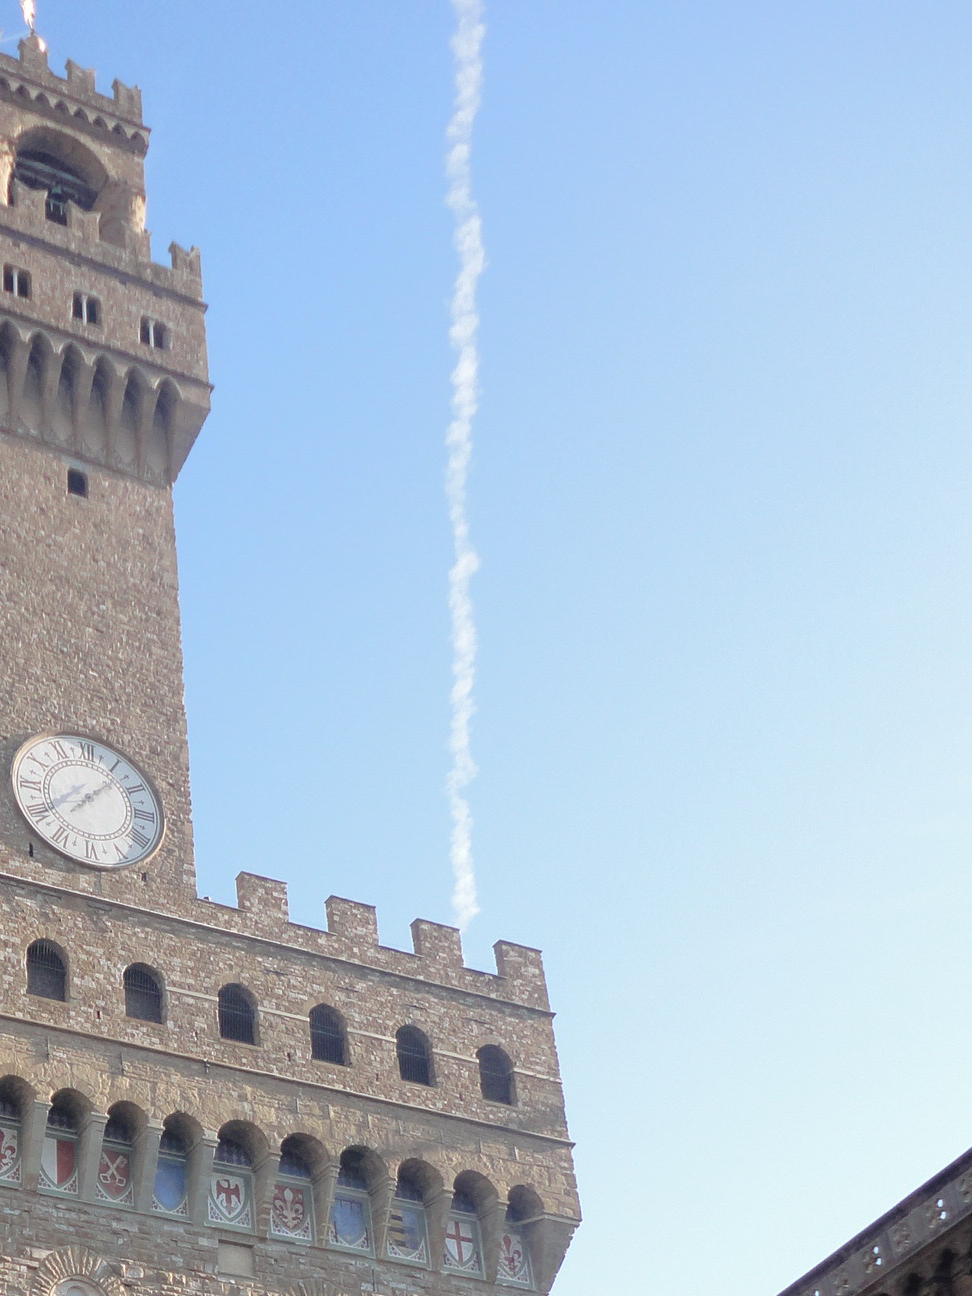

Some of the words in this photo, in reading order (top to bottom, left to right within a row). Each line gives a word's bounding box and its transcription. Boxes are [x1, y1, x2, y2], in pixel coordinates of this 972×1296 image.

[48, 740, 70, 760] XI
[77, 741, 96, 763] XII
[26, 752, 49, 772] X
[124, 783, 146, 796] II
[26, 800, 50, 825] VIII
[133, 807, 155, 825] III
[49, 825, 69, 849] VII
[124, 825, 150, 850] IIII
[84, 839, 100, 861] VI
[113, 842, 129, 861] V
